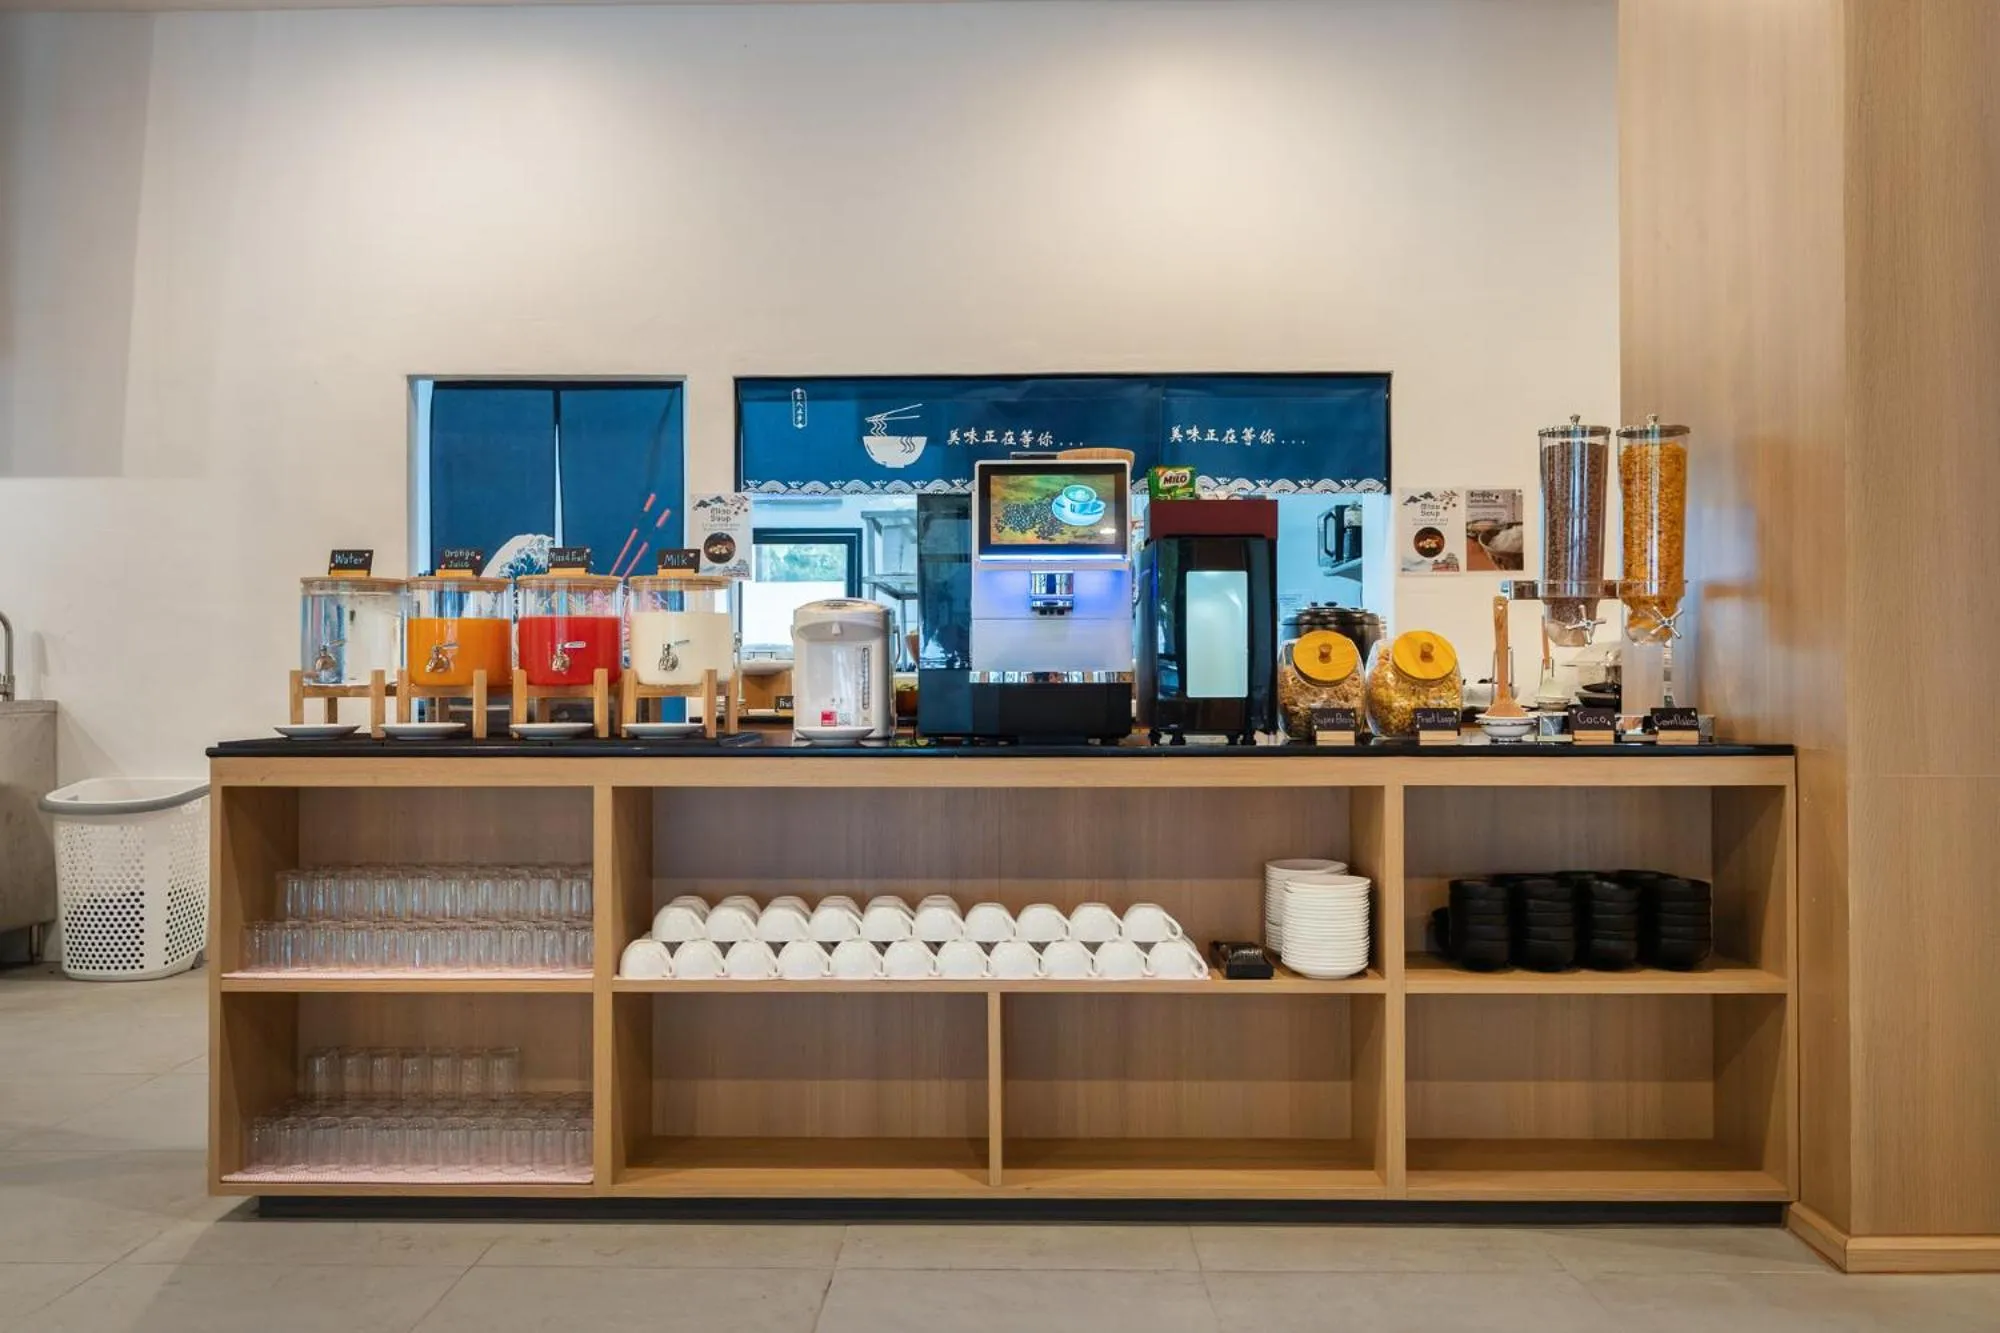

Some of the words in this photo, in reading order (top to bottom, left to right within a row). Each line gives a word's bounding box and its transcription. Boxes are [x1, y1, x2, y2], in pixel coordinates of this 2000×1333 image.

[1163, 474, 1188, 485] MILO
[335, 553, 364, 565] Water
[444, 550, 475, 561] Orange
[663, 553, 688, 566] Milk
[1313, 713, 1335, 726] Super
[1576, 711, 1606, 725] Coco
